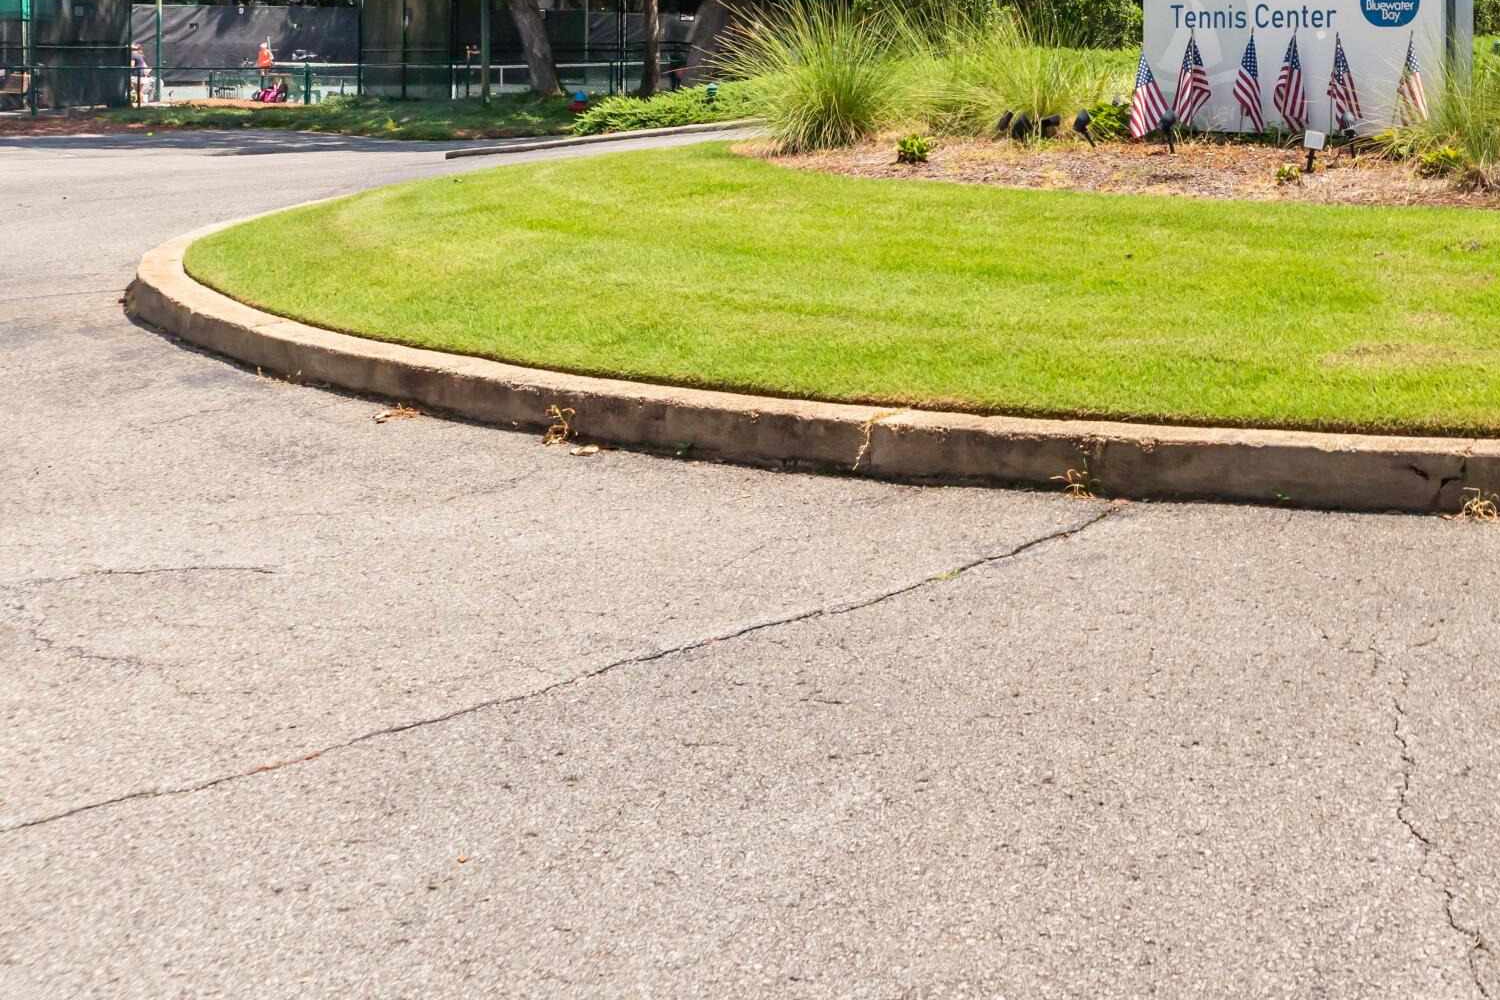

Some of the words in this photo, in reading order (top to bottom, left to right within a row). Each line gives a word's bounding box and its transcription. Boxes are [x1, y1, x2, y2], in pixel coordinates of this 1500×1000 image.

[1366, 0, 1414, 10] Bluewater
[1170, 4, 1247, 29] Tennis
[1255, 3, 1337, 29] Center
[1382, 9, 1401, 23] Bay
